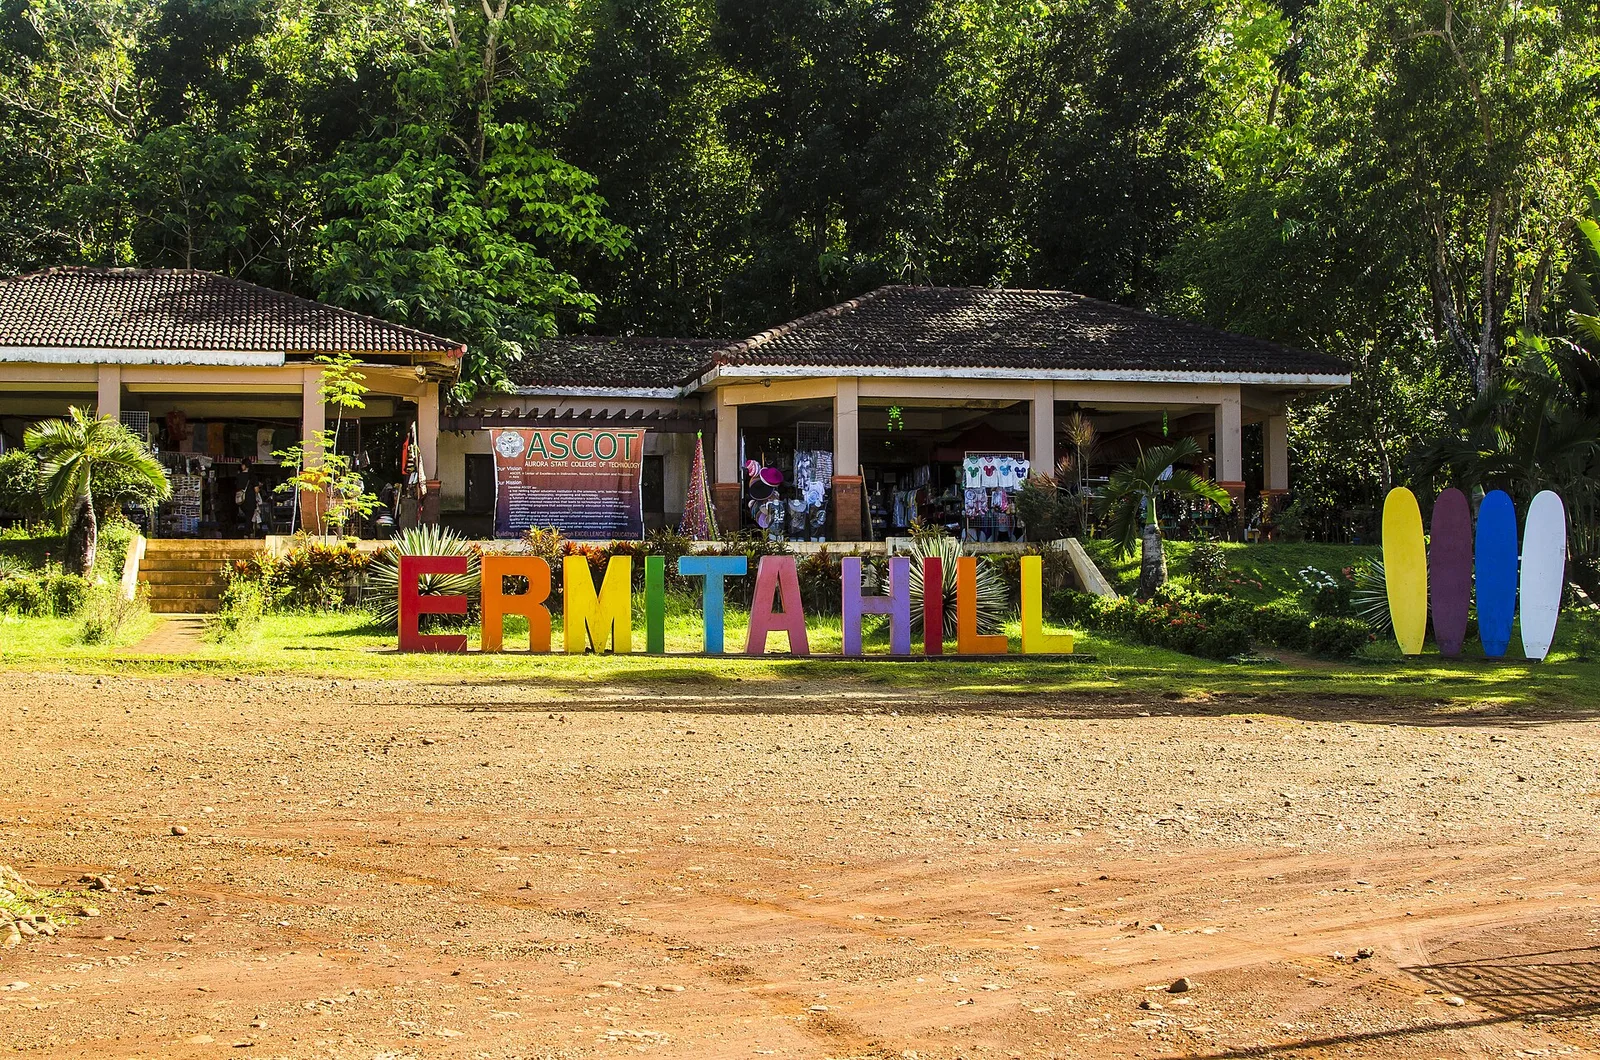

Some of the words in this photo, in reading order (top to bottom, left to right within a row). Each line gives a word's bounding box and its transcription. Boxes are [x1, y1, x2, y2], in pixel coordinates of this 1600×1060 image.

[526, 432, 638, 460] ASCOT
[398, 556, 810, 655] ERMITA
[842, 556, 1074, 655] HILL
